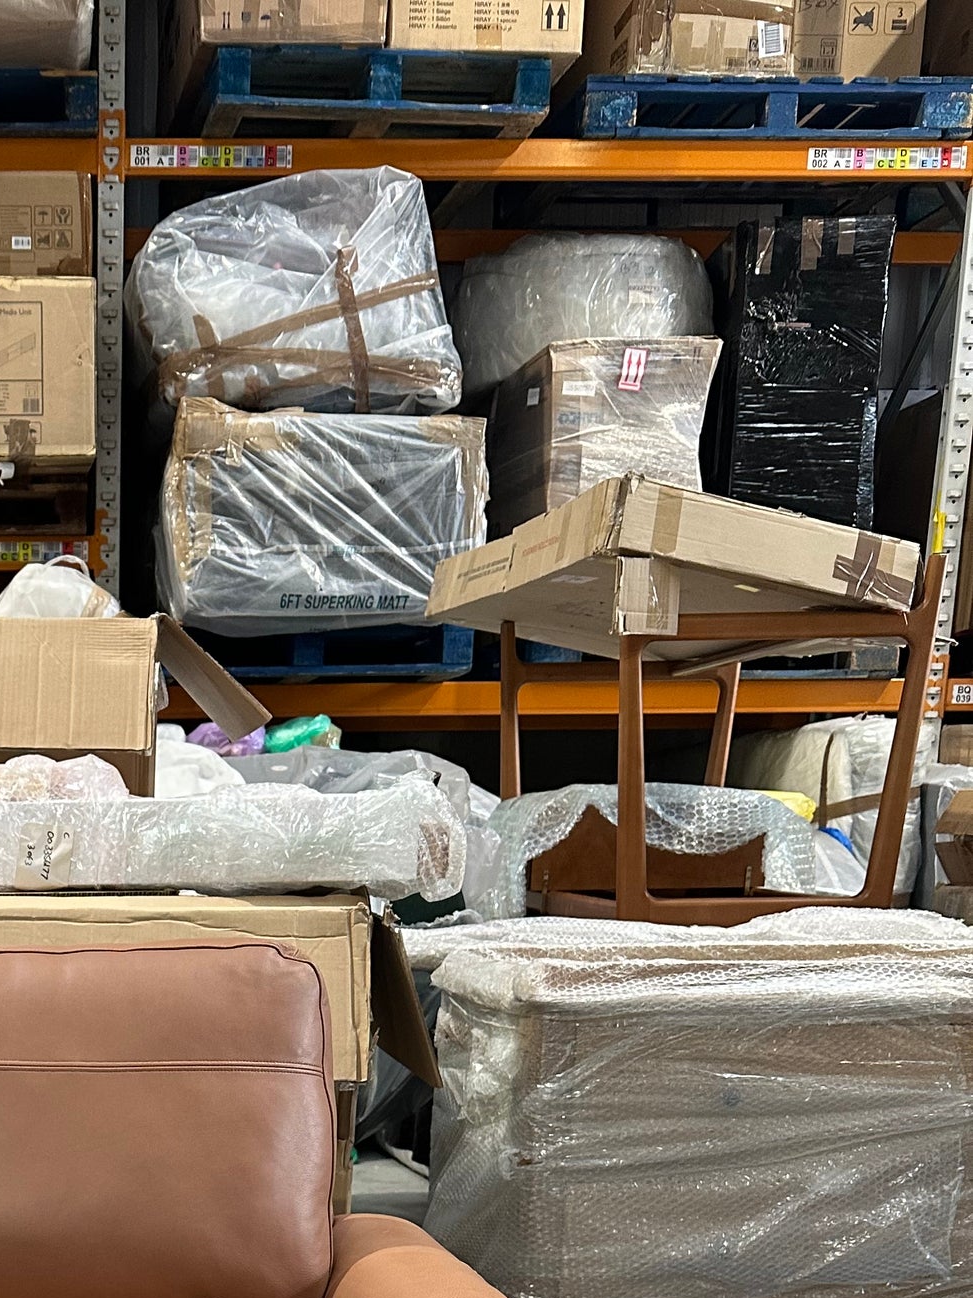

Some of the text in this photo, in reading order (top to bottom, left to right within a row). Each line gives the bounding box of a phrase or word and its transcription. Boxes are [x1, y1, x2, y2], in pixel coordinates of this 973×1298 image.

[898, 7, 904, 17] 3
[135, 147, 150, 156] BR
[180, 147, 187, 155] B
[224, 147, 231, 155] D
[814, 148, 949, 158] BR B D F
[135, 157, 150, 166] 001
[157, 158, 164, 166] A
[201, 158, 209, 166] C
[246, 158, 252, 166] E
[812, 159, 928, 168] 002 A C E
[0, 308, 17, 316] Media
[1, 553, 7, 561] C
[280, 593, 410, 610] 6FT SUPERKING MATT
[958, 686, 971, 694] BQ
